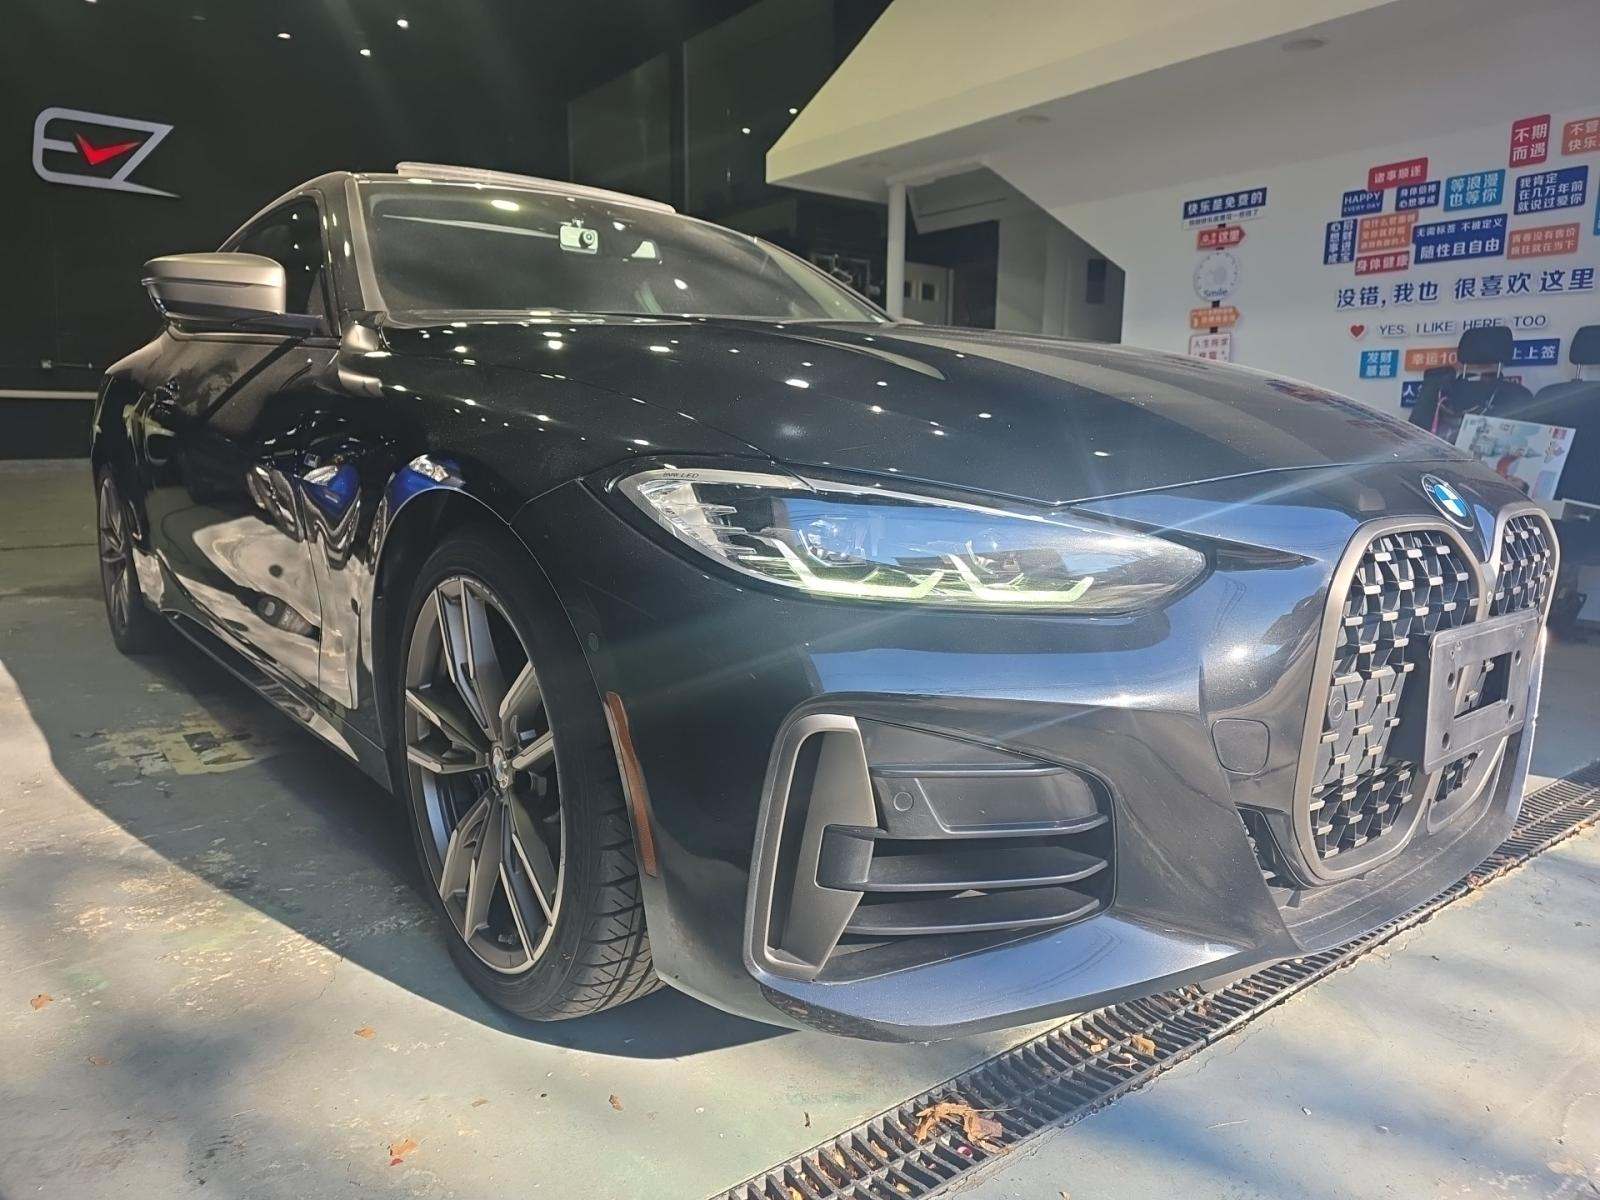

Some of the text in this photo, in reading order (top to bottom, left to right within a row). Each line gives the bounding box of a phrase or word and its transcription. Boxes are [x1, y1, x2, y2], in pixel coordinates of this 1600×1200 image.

[1513, 123, 1548, 142] 不期
[1512, 143, 1546, 162] 而遇
[1567, 136, 1600, 151] 快乐
[1450, 172, 1499, 193] 等浪漫
[1520, 172, 1558, 188] 我肯定
[1344, 191, 1381, 204] HAPPY
[1449, 188, 1497, 208] 也等你
[1519, 180, 1583, 200] 在几万年前
[1343, 202, 1381, 213] EVERY DAY
[1518, 193, 1583, 213] 就说过爱你
[1420, 238, 1500, 260] 随性且自由
[1356, 254, 1409, 272] 身体健康
[1423, 320, 1451, 333] LIKE
[1463, 318, 1502, 330] HERE
[1512, 315, 1547, 327] TOO
[1366, 352, 1392, 364] 发财
